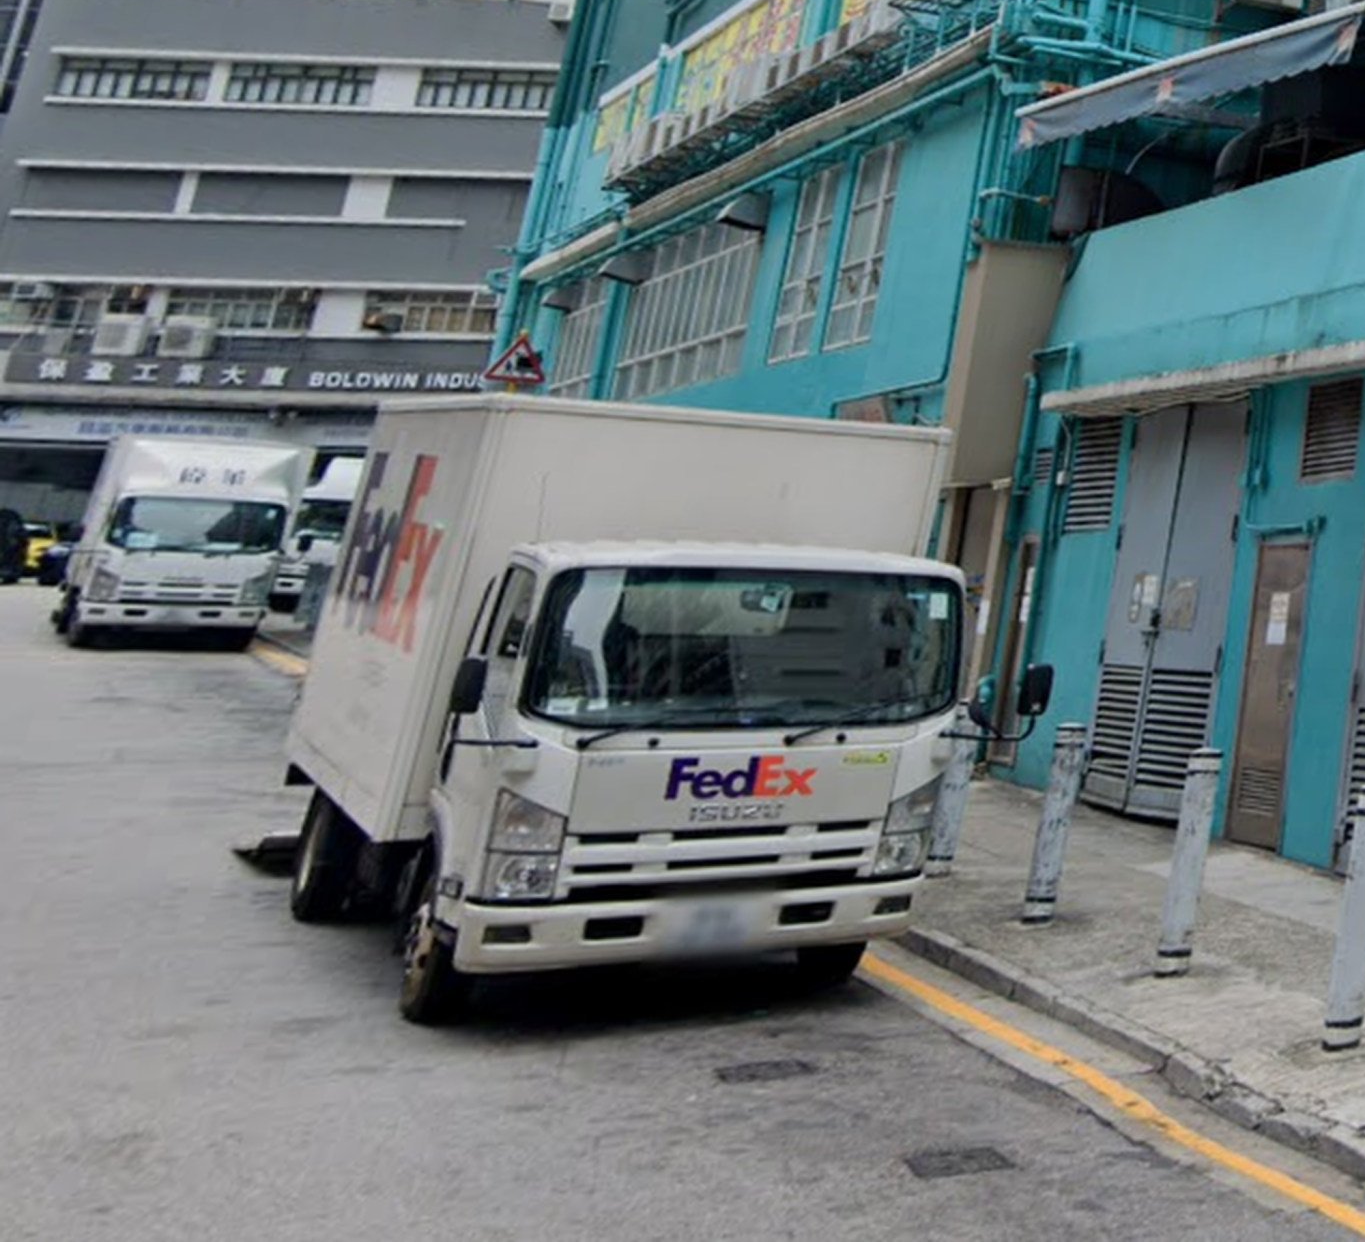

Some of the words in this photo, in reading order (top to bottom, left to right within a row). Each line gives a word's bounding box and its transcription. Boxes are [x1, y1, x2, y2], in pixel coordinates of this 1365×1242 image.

[308, 371, 418, 388] BOLDWIN
[664, 755, 818, 801] FedEx
[687, 803, 786, 822] ISUZU
